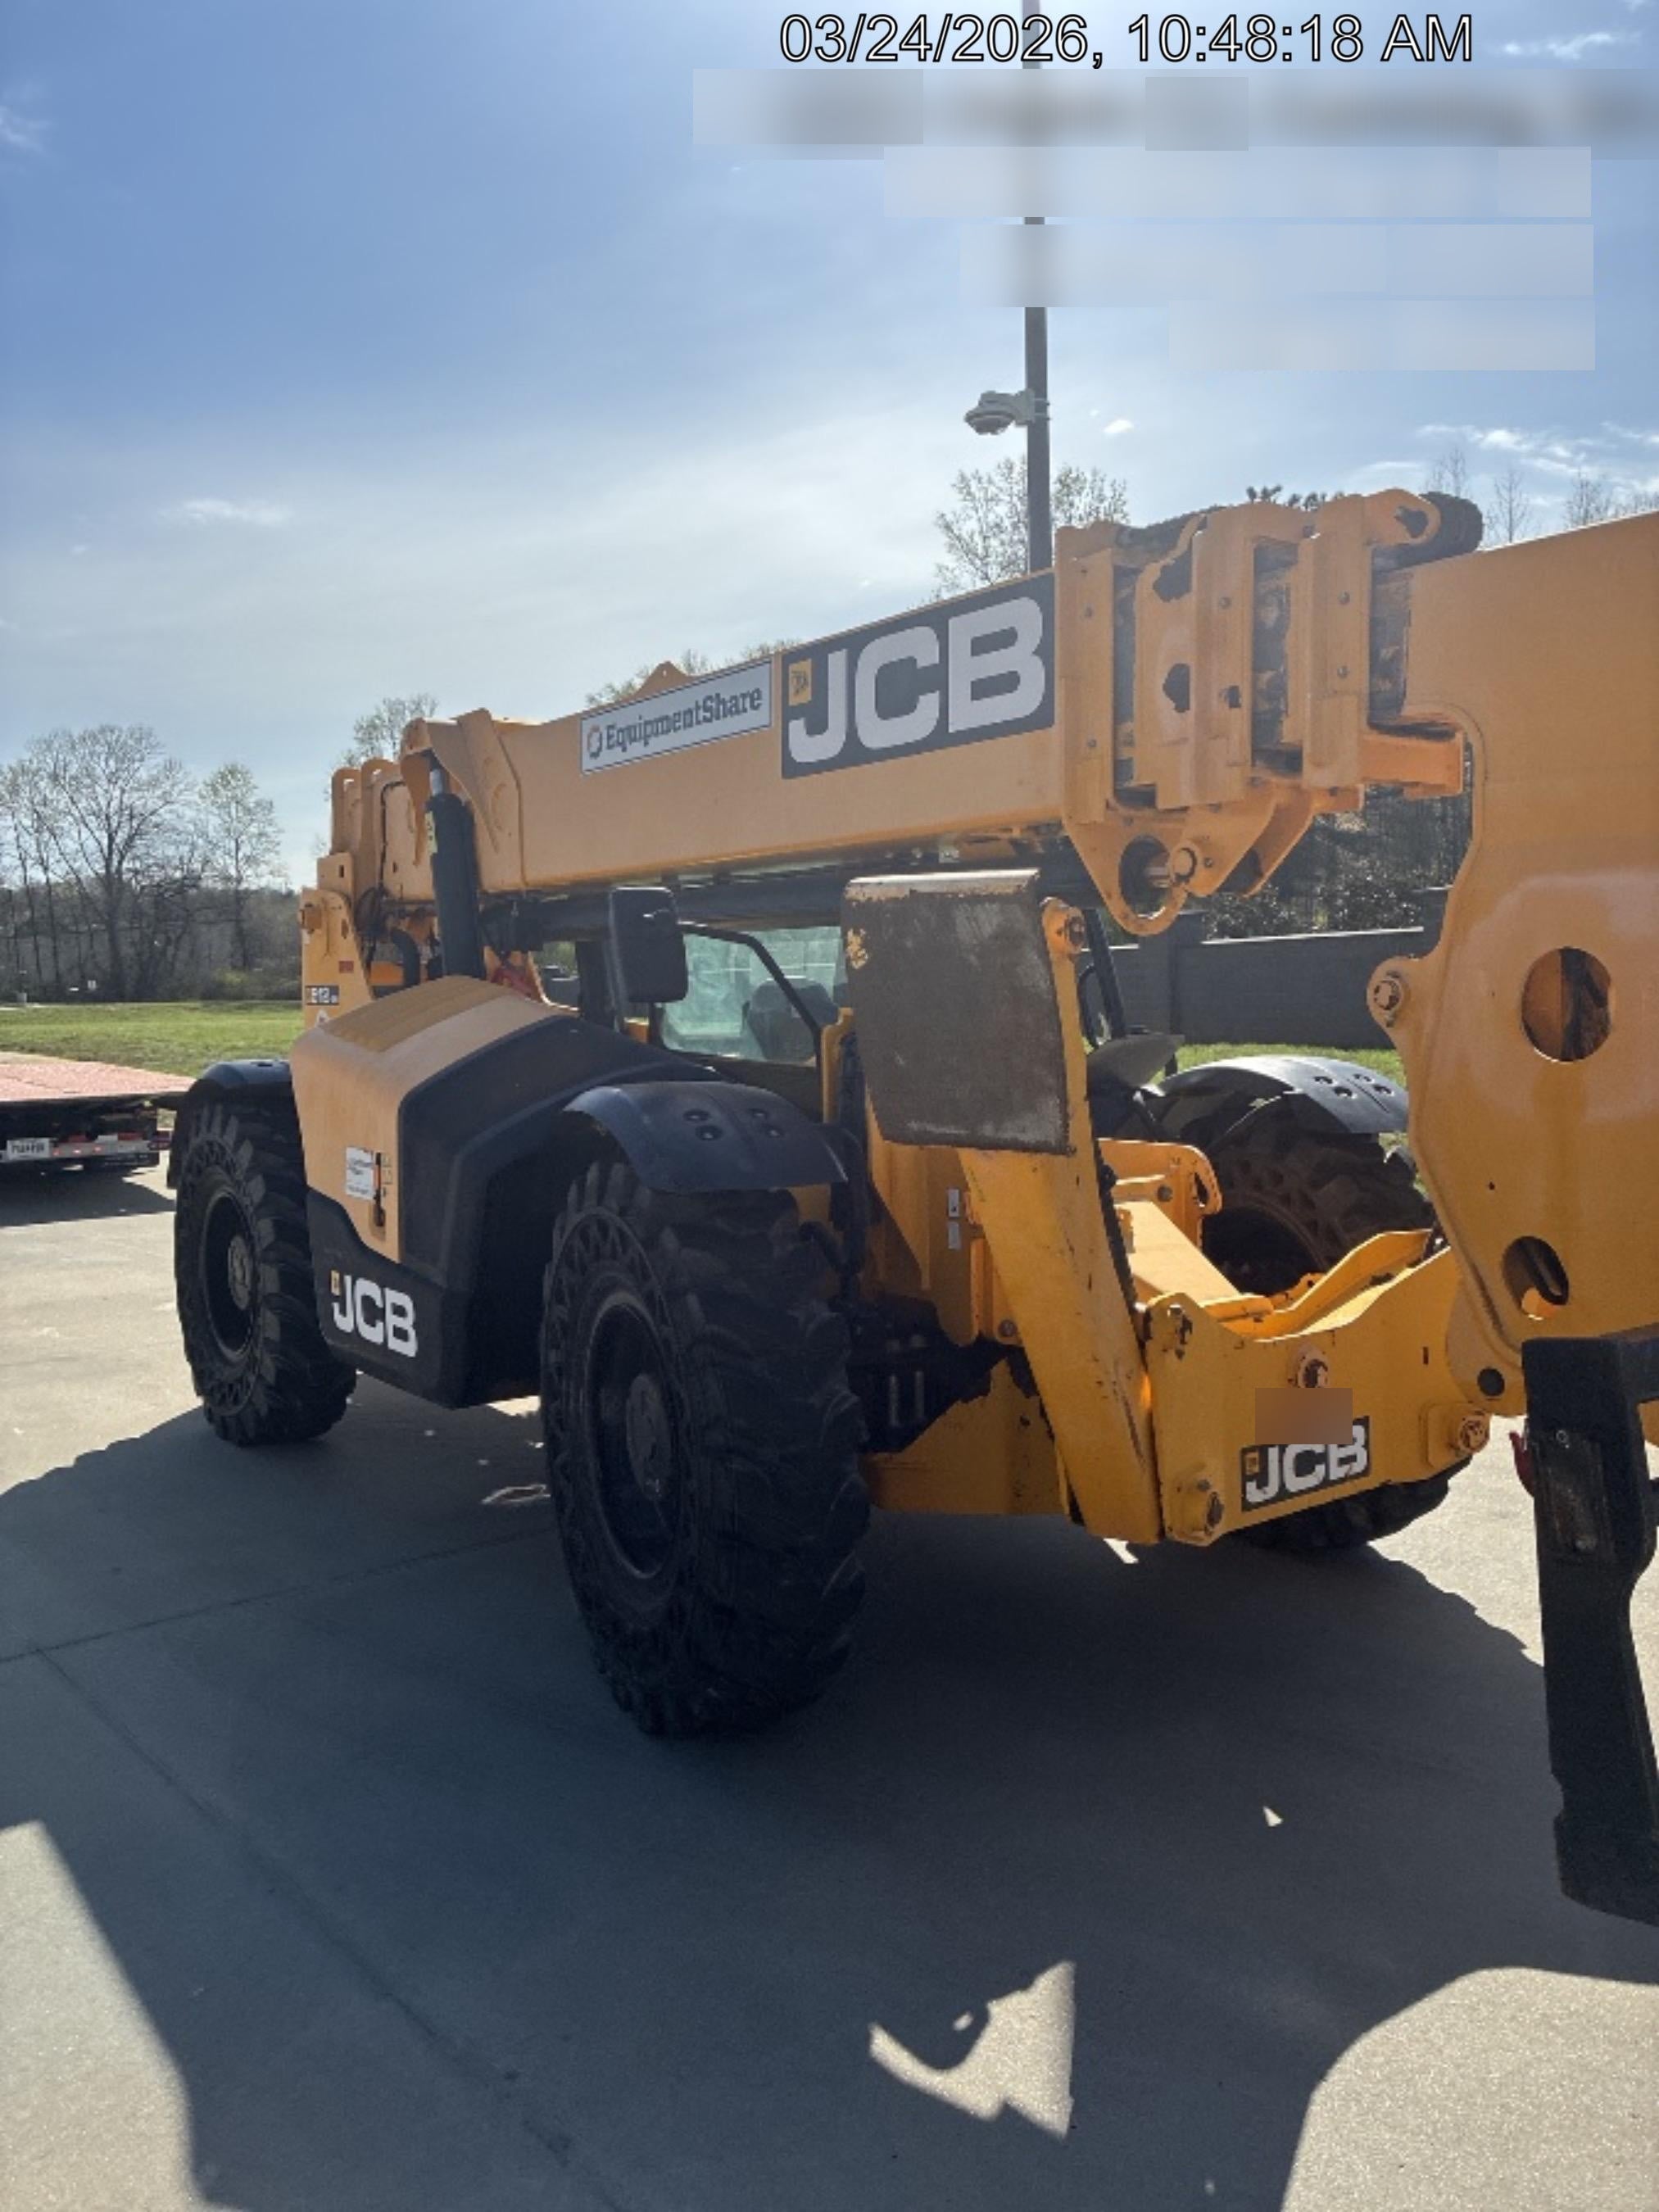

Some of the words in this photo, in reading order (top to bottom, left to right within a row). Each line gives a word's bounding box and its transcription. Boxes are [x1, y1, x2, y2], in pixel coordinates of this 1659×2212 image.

[605, 687, 764, 753] EquipmentShare
[788, 596, 1045, 764] JCB
[331, 1275, 419, 1358] JCB
[1245, 1424, 1368, 1503] JCB
